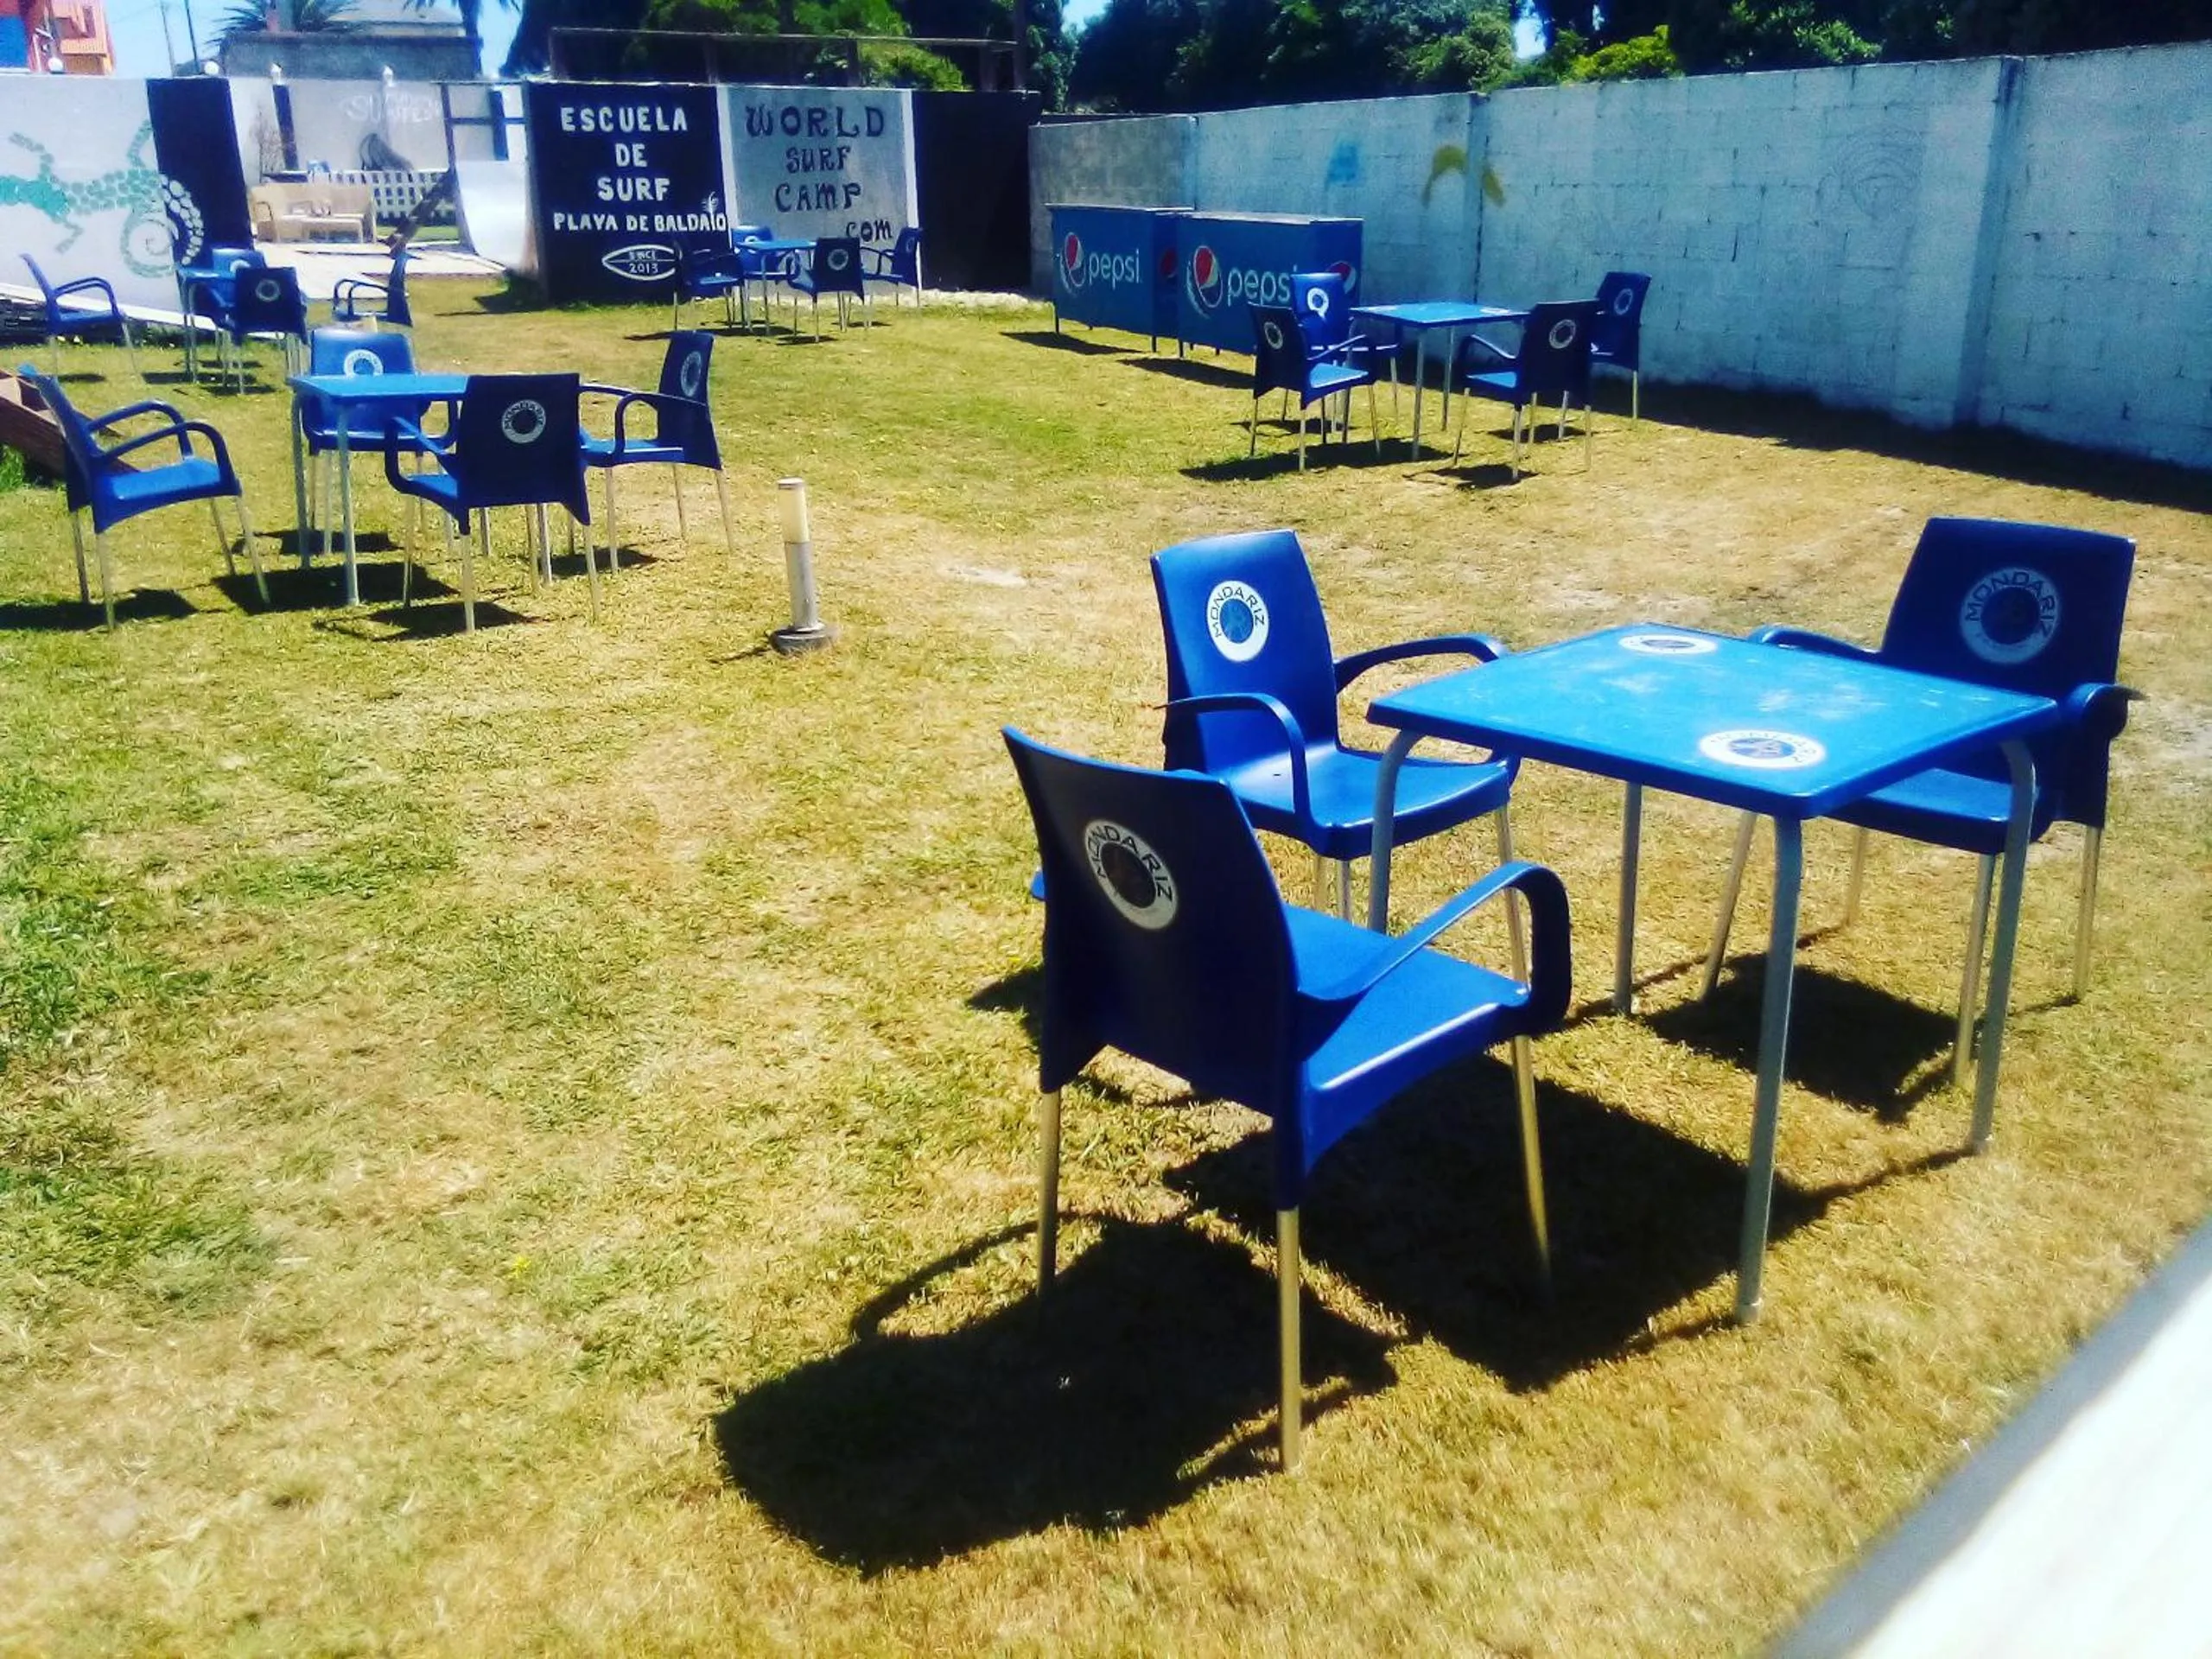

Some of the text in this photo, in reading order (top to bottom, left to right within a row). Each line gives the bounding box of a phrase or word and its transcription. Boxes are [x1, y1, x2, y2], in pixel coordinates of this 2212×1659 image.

[561, 106, 688, 132] ESCUELA
[746, 105, 885, 137] WORLD
[615, 143, 647, 167] DE
[785, 145, 851, 173] SURF
[597, 176, 670, 201] SURF
[775, 181, 861, 213] CAMP
[554, 212, 727, 232] PLAYA DE BALDAIO
[1089, 248, 1141, 290] pepsi
[1227, 264, 1298, 308] peps
[1210, 586, 1265, 638] MONDARIZ
[1965, 571, 2056, 638] MONDARIZ
